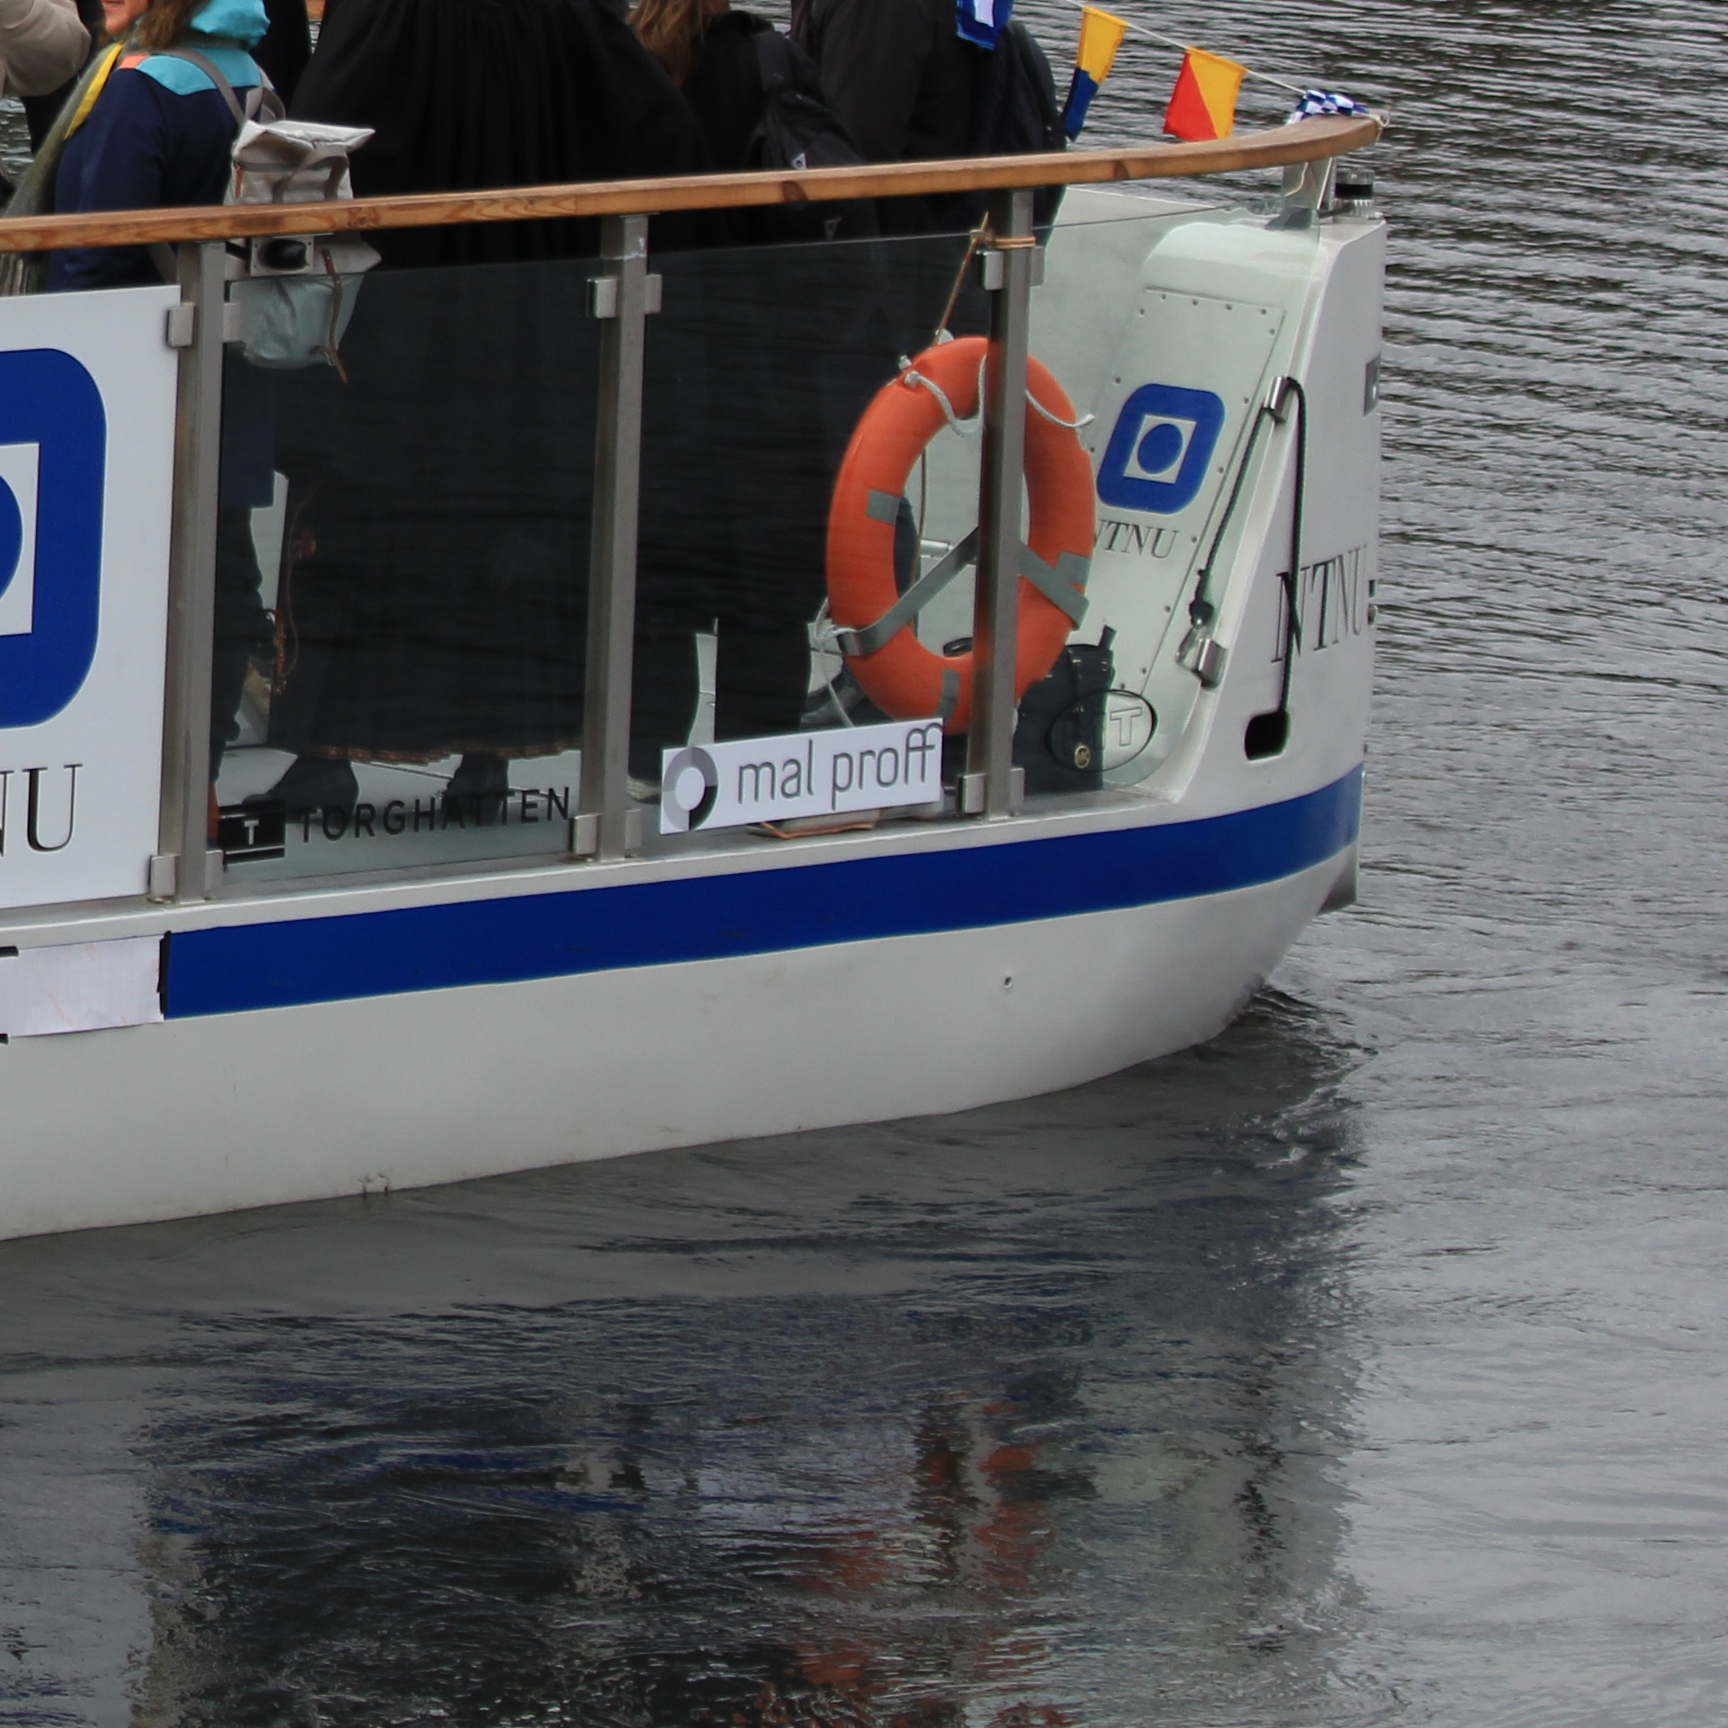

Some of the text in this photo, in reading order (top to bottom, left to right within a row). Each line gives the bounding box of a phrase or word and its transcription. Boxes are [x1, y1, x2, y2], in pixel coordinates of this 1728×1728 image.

[1271, 543, 1368, 663] NTNU
[738, 722, 943, 811] mal proff
[300, 786, 571, 844] TORGHATTEN
